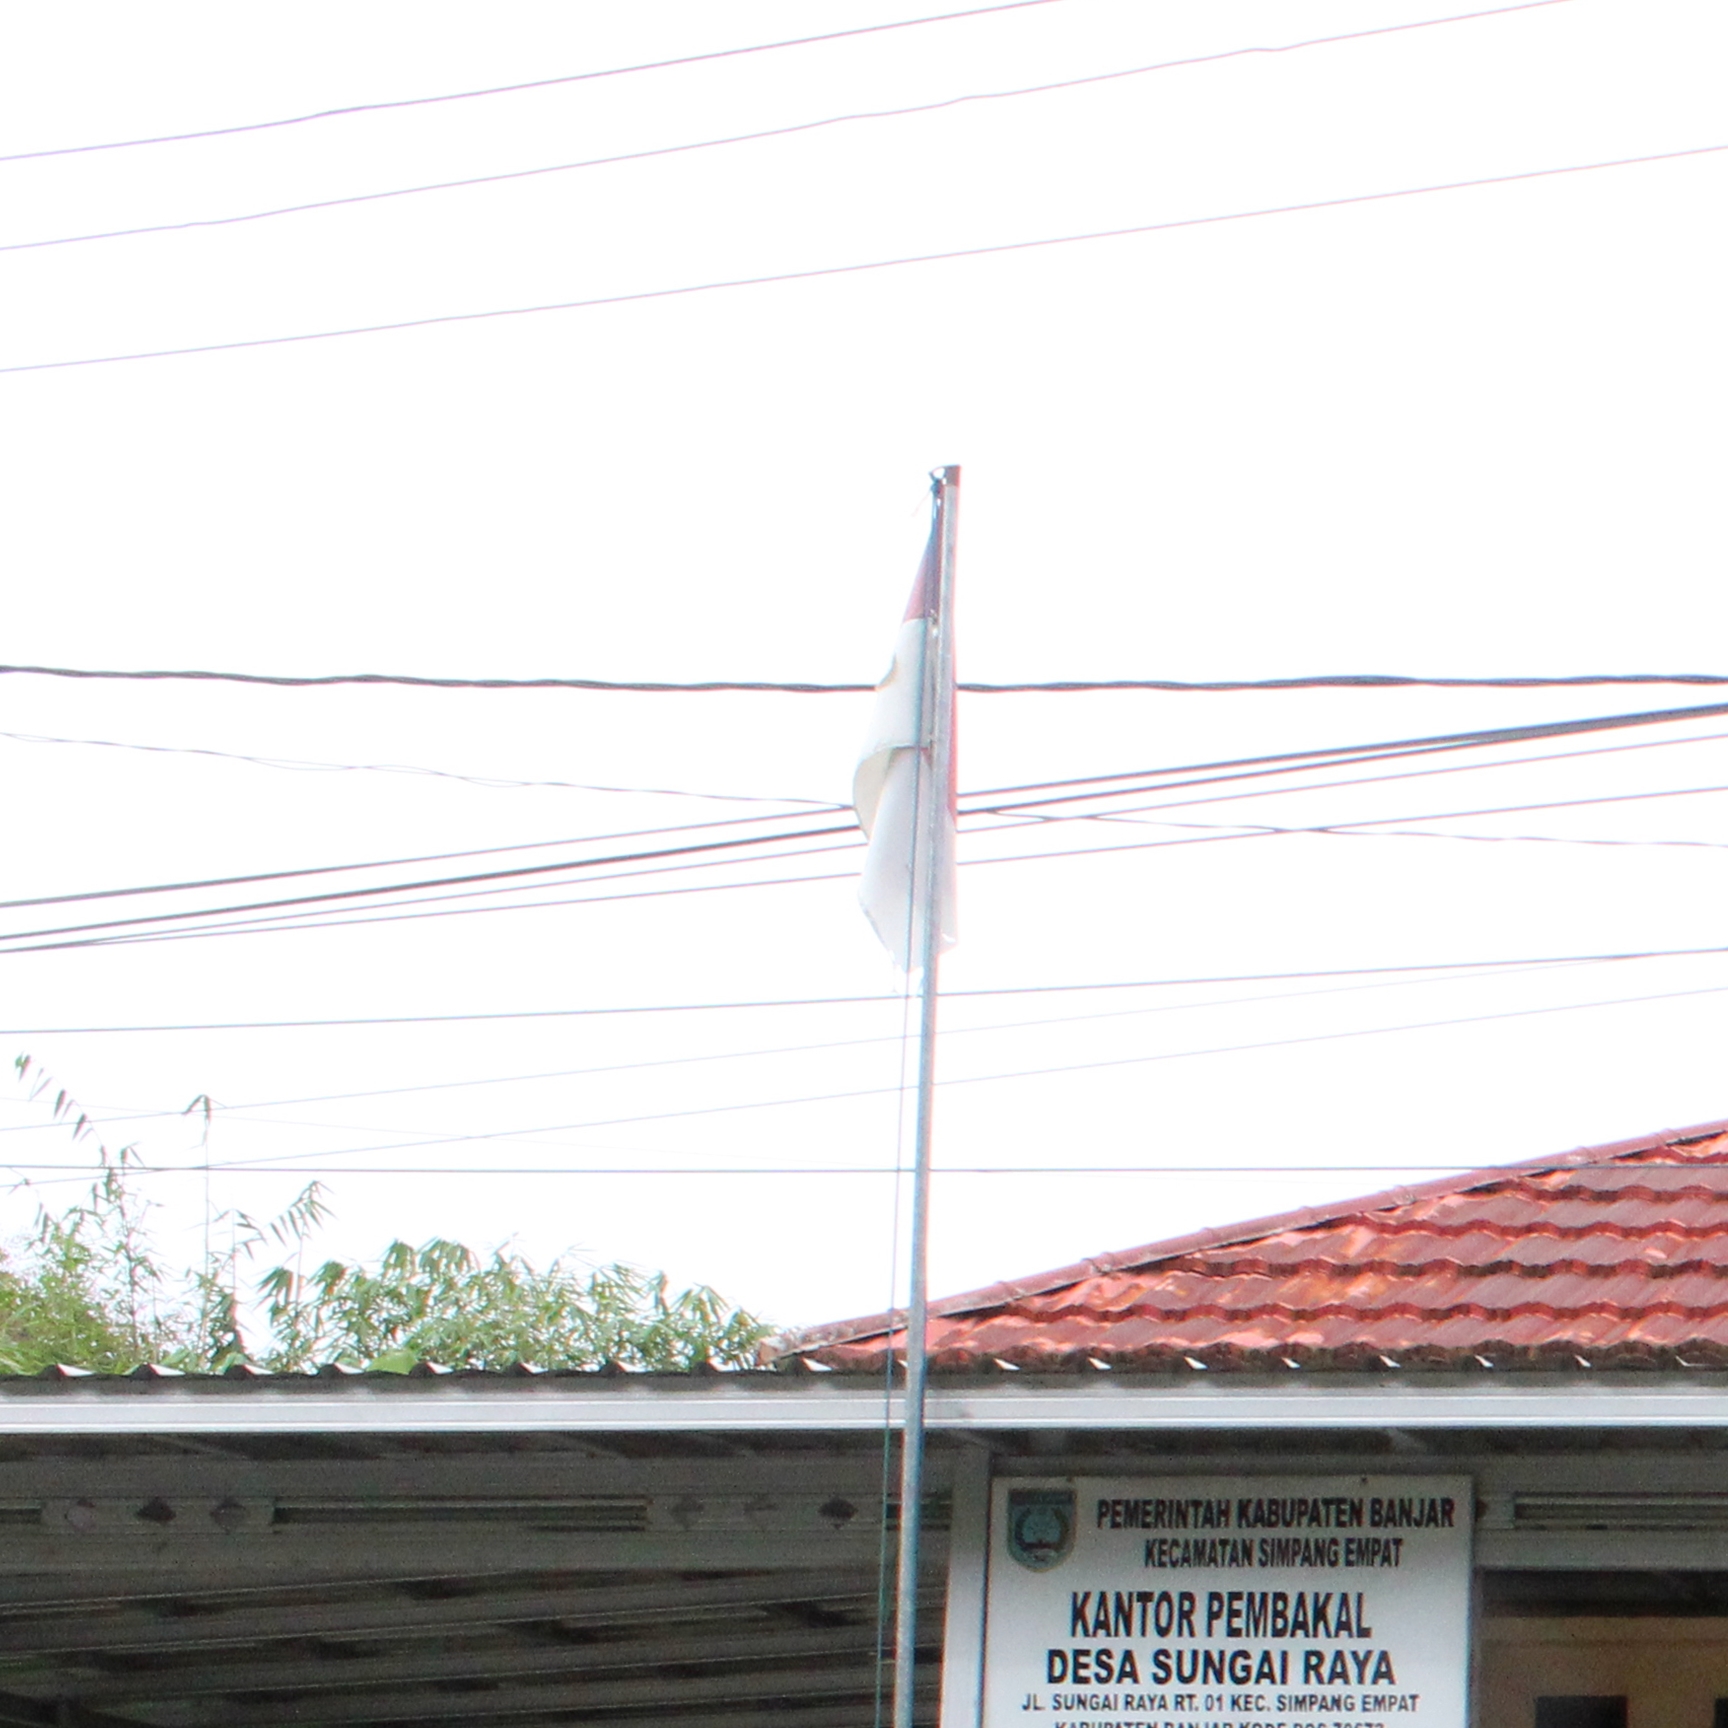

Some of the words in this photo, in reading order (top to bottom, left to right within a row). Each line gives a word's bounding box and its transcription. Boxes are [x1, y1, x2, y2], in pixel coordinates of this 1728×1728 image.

[1097, 1497, 1229, 1529] PEMERINTAH
[1237, 1499, 1362, 1528] KABUPATEN
[1369, 1499, 1454, 1528] BANJAR
[1145, 1539, 1252, 1568] KECAMATAN
[1259, 1539, 1339, 1567] SIMPANG
[1344, 1539, 1403, 1567] EMPAT
[1071, 1592, 1196, 1638] KANTOR
[1207, 1593, 1372, 1639] PEMBAKAL
[1047, 1649, 1139, 1685] DESA
[1152, 1650, 1289, 1685] SUNGAI
[1304, 1650, 1395, 1685] RAYA
[1052, 1694, 1118, 1712] SUNGAI
[1124, 1695, 1168, 1712] RAYA
[1174, 1695, 1199, 1712] RT.
[1205, 1695, 1224, 1712] 01
[1231, 1695, 1271, 1713] KEC.
[1277, 1695, 1355, 1713] SIMPANG
[1362, 1695, 1418, 1712] EMPAT
